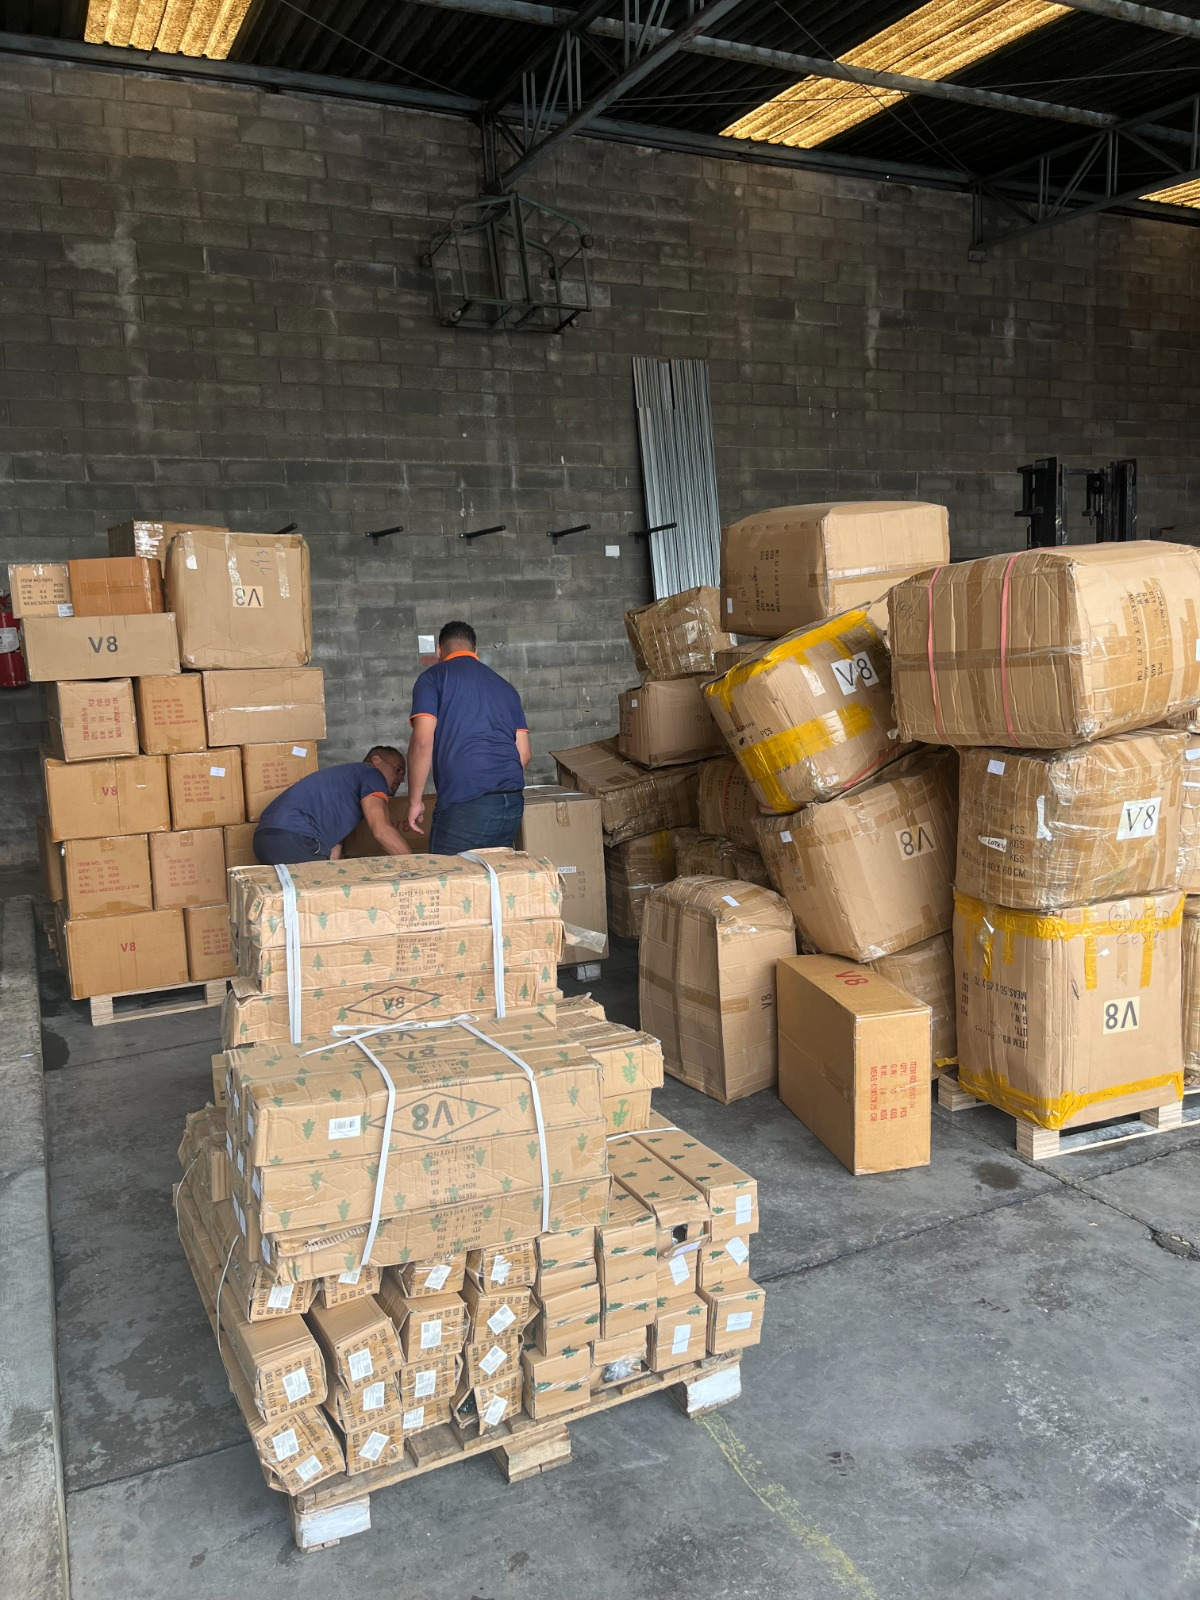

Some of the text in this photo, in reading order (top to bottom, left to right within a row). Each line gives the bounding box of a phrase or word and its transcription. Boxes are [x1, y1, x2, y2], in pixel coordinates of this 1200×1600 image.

[235, 588, 262, 606] V8
[88, 636, 118, 654] V8
[835, 657, 873, 687] V8
[1137, 670, 1143, 681] CM
[759, 727, 772, 738] PCS
[102, 786, 118, 797] V8
[1125, 804, 1156, 832] V8
[1010, 824, 1025, 835] PCS
[900, 826, 934, 856] V8
[1009, 839, 1025, 849] KGS
[1010, 853, 1025, 864] KGS
[1014, 867, 1026, 878] CM
[120, 942, 136, 952] V8
[835, 970, 869, 986] V8
[761, 993, 773, 1011] V8
[1105, 1000, 1138, 1030] V8
[1012, 1037, 1028, 1050] ITEM
[411, 1100, 454, 1131] V8
[870, 1113, 877, 1122] CM
[880, 1109, 888, 1120] KGS
[356, 1287, 365, 1295] PCS
[379, 1365, 388, 1375] PCS
